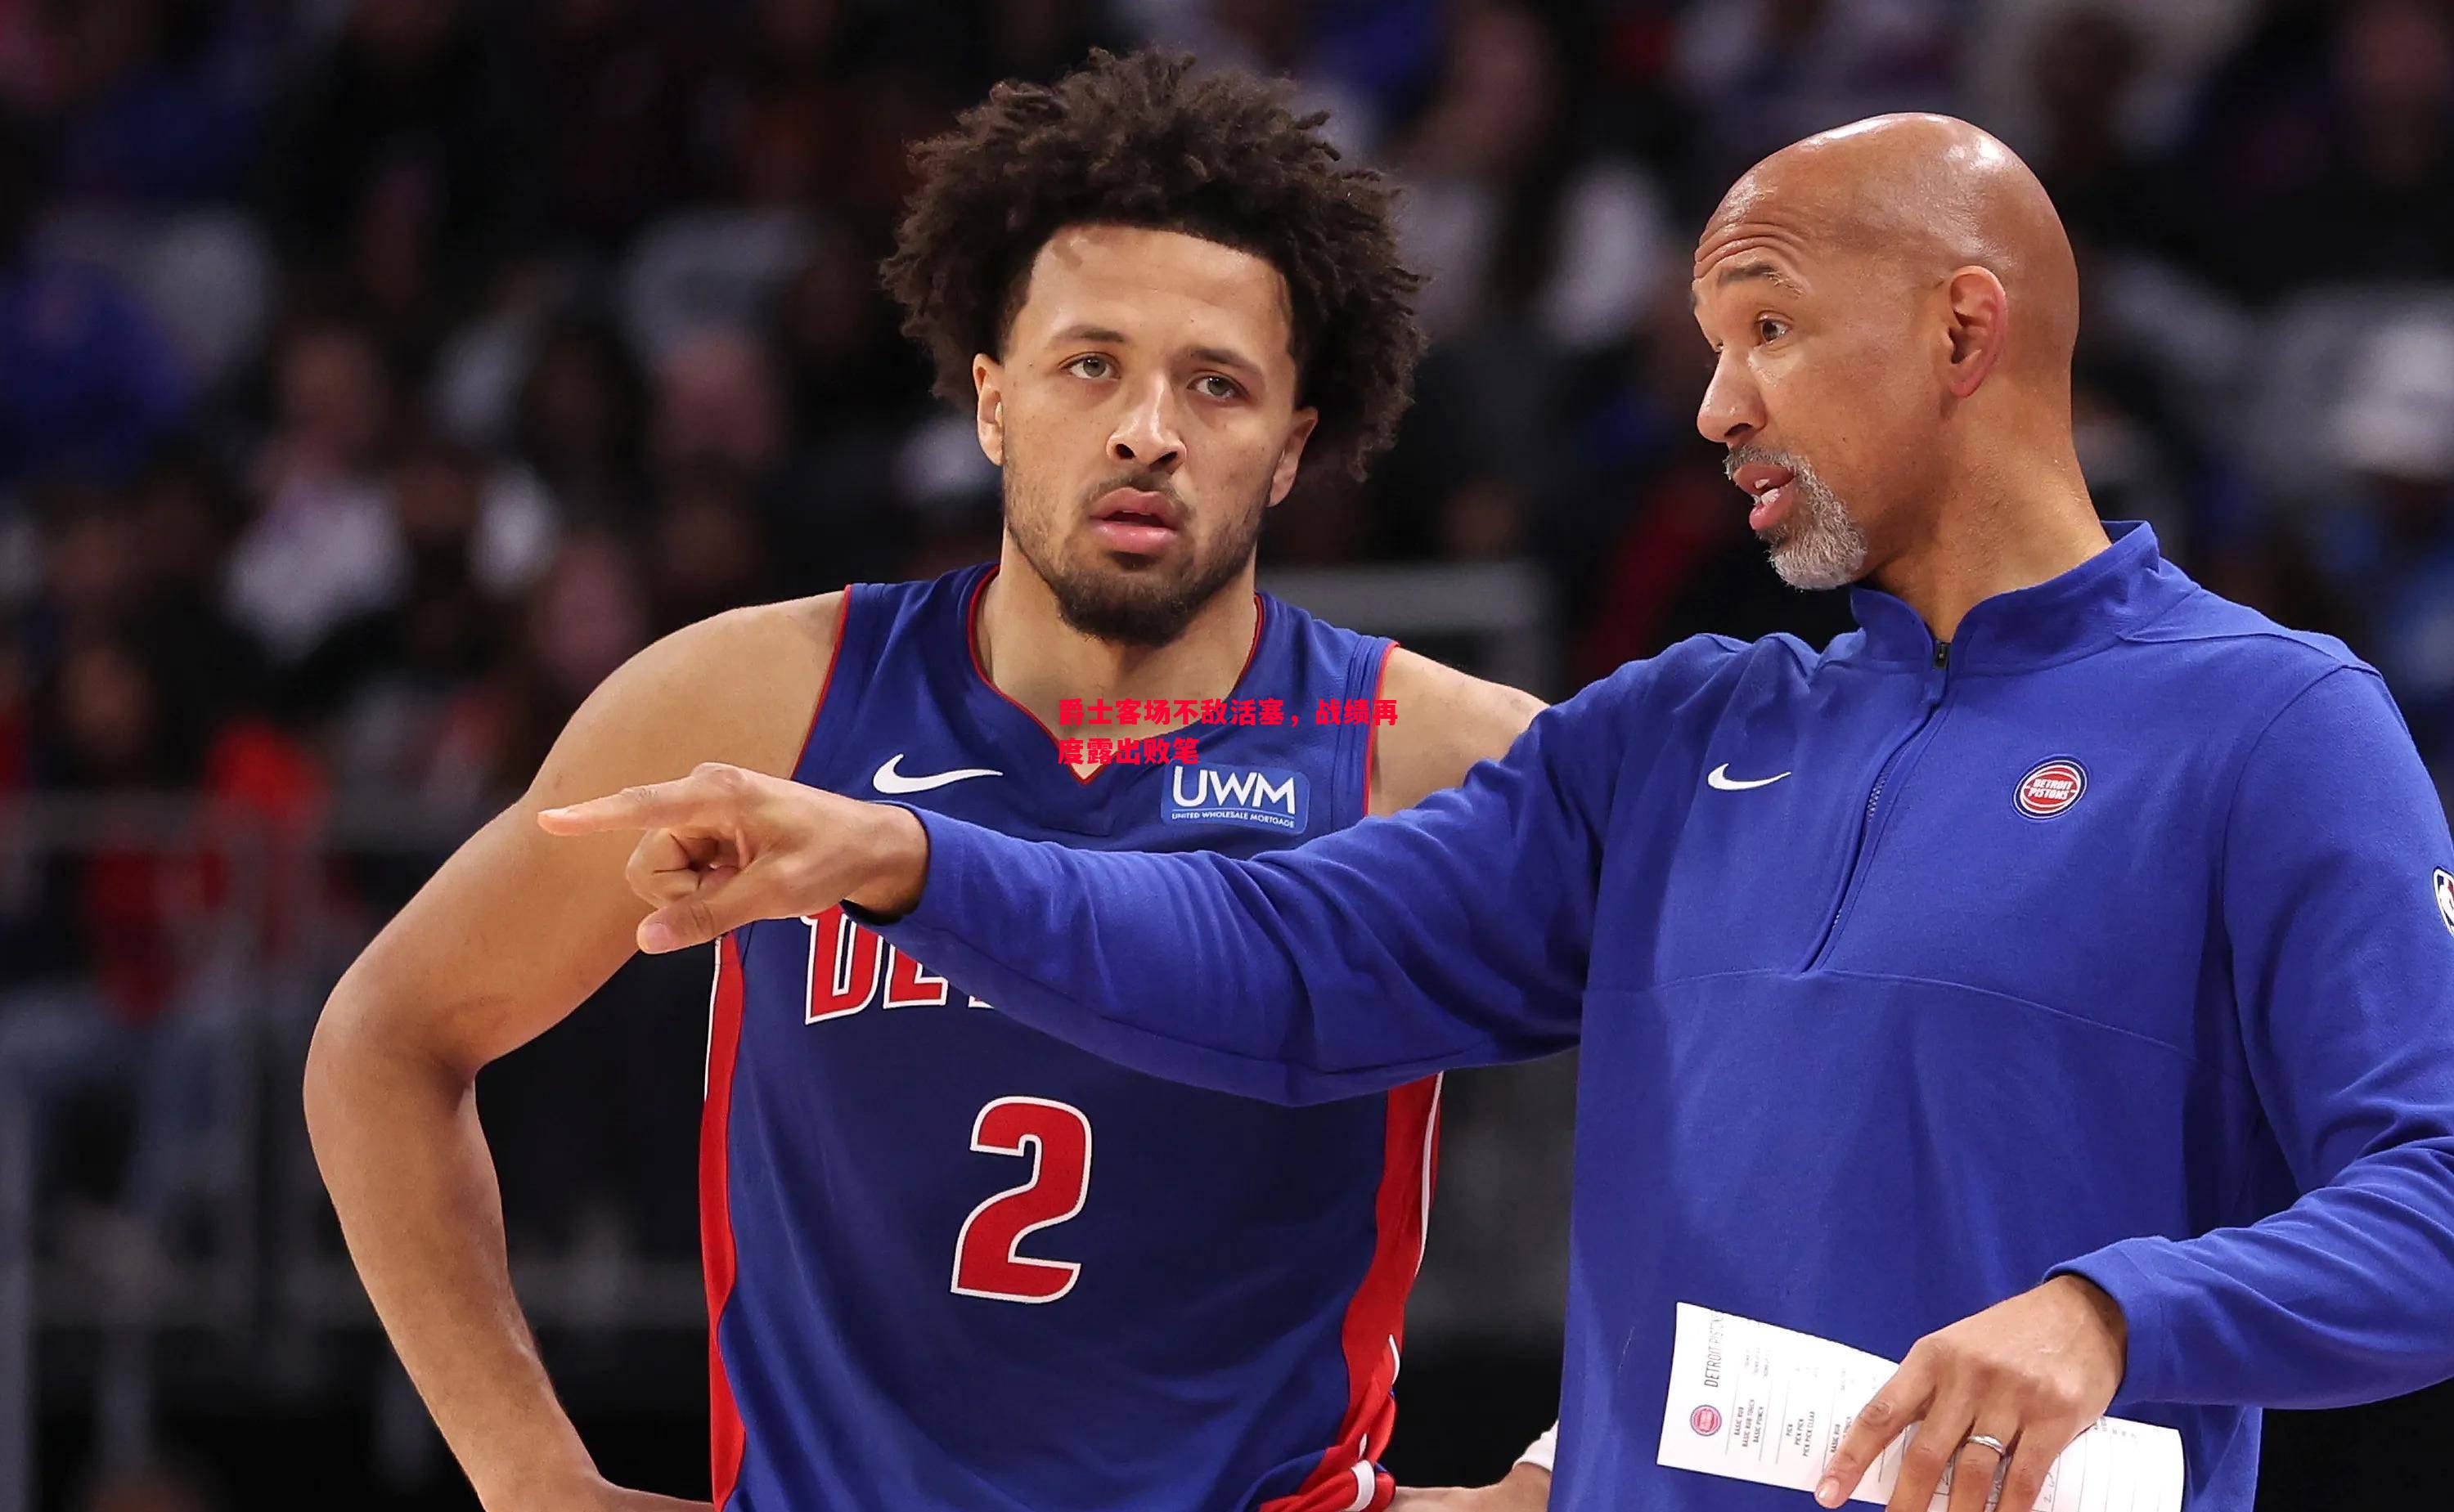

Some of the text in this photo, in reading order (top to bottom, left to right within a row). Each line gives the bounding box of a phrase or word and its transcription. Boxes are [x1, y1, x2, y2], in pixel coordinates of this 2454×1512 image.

[1173, 765, 1296, 815] UWM
[2027, 787, 2070, 801] PISTONS
[2033, 778, 2074, 791] DETROIT
[1202, 811, 1248, 821] WHOLESALE
[1249, 814, 1295, 828] MORTGAGE
[800, 904, 994, 1025] DE
[951, 1096, 1093, 1304] 2
[1704, 1346, 1722, 1388] DETROIT
